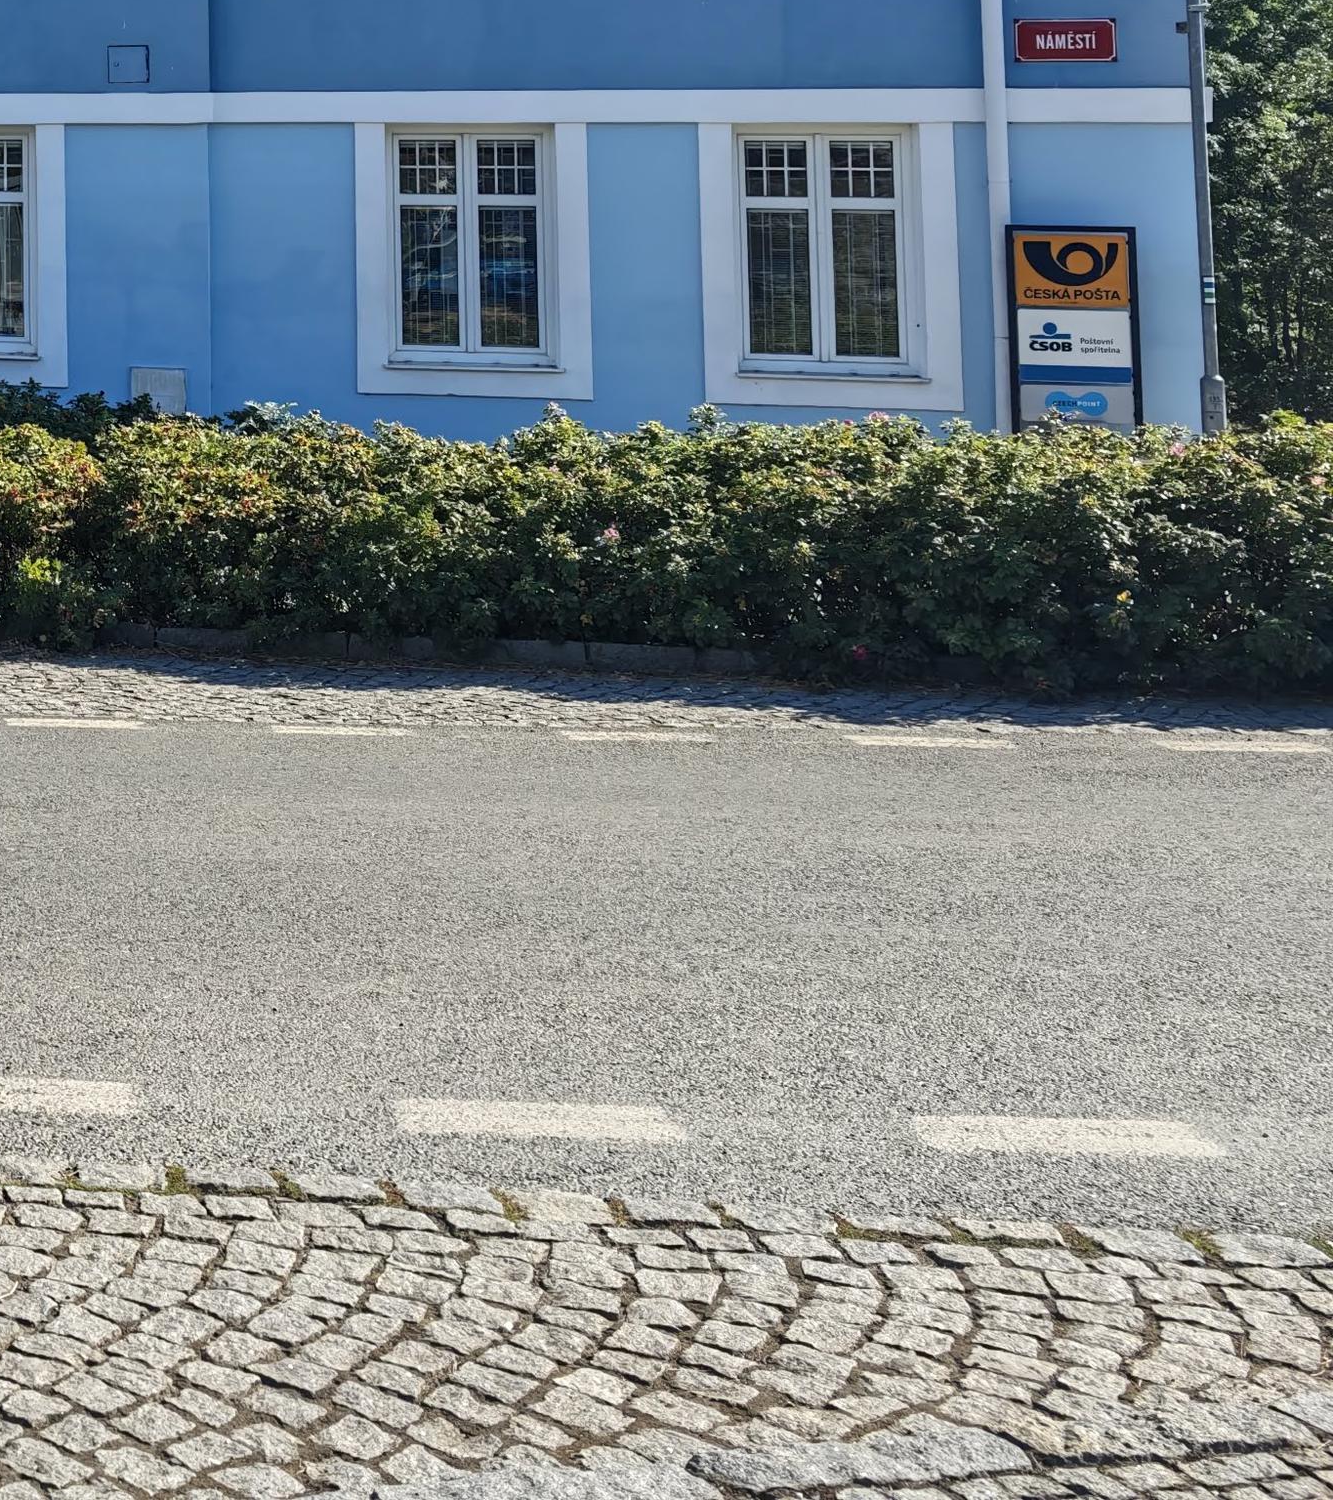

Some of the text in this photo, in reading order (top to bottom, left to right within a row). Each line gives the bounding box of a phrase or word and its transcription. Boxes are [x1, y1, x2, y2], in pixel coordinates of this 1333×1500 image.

[1035, 31, 1096, 49] NÁMĚSTÍ
[1023, 286, 1121, 301] ČESKÁ POŠTA
[1029, 340, 1072, 352] ČSOB
[1080, 337, 1114, 345] Poštovní
[1080, 345, 1121, 354] spořitelna
